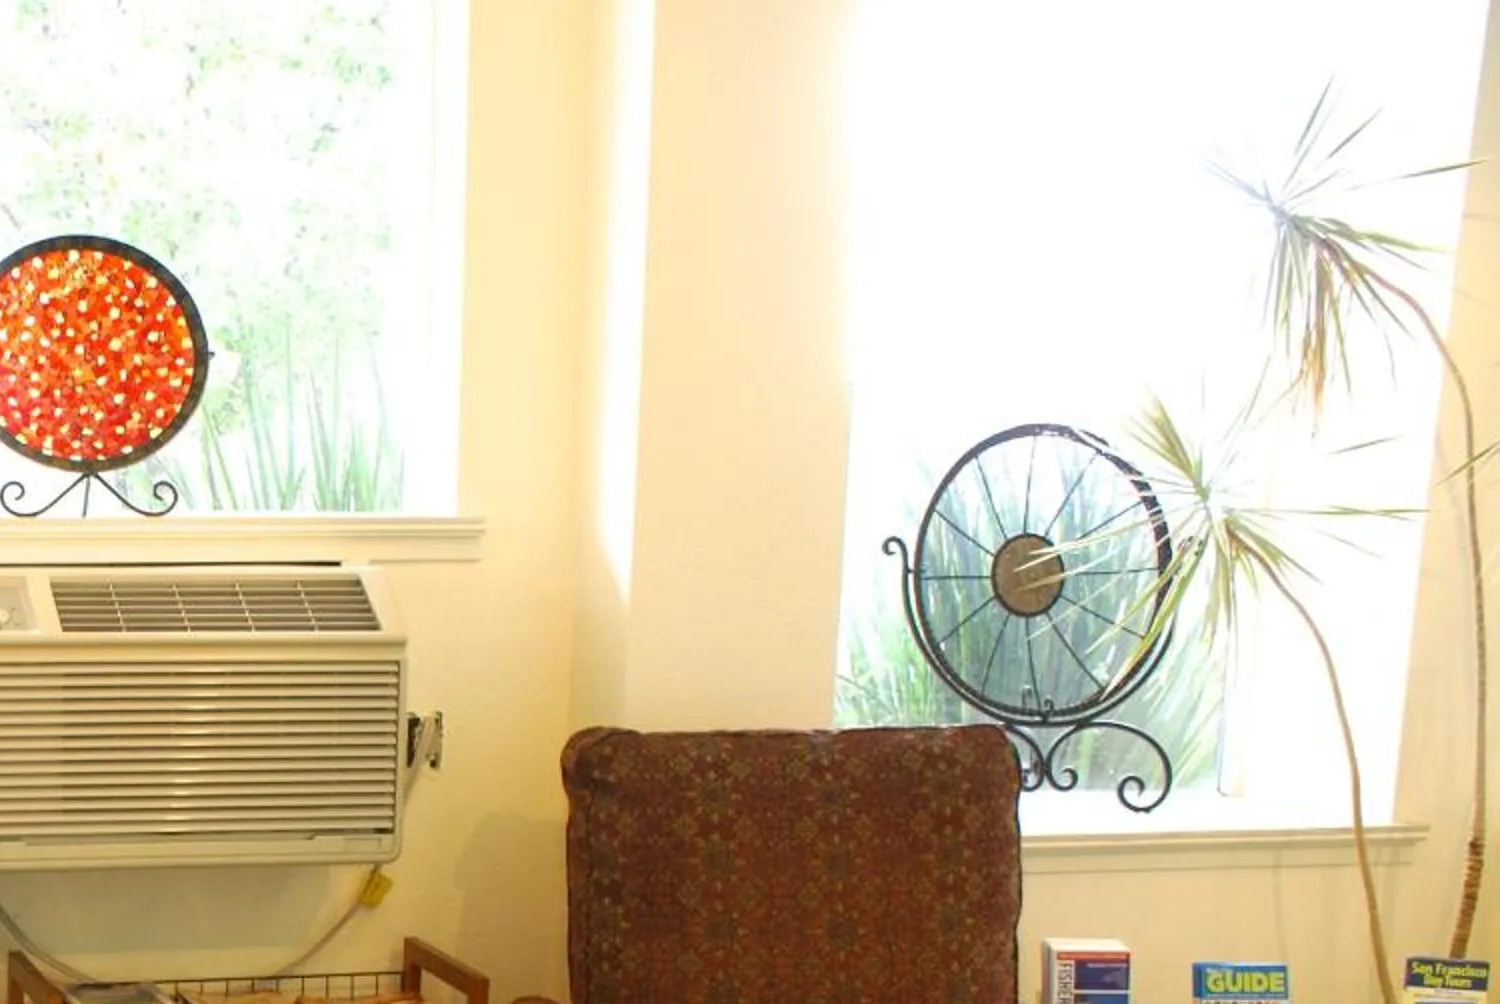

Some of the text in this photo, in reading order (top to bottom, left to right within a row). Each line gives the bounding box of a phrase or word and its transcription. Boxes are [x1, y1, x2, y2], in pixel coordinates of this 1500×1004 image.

[1412, 961, 1488, 978] San Francisco
[1206, 970, 1286, 993] GUIDE
